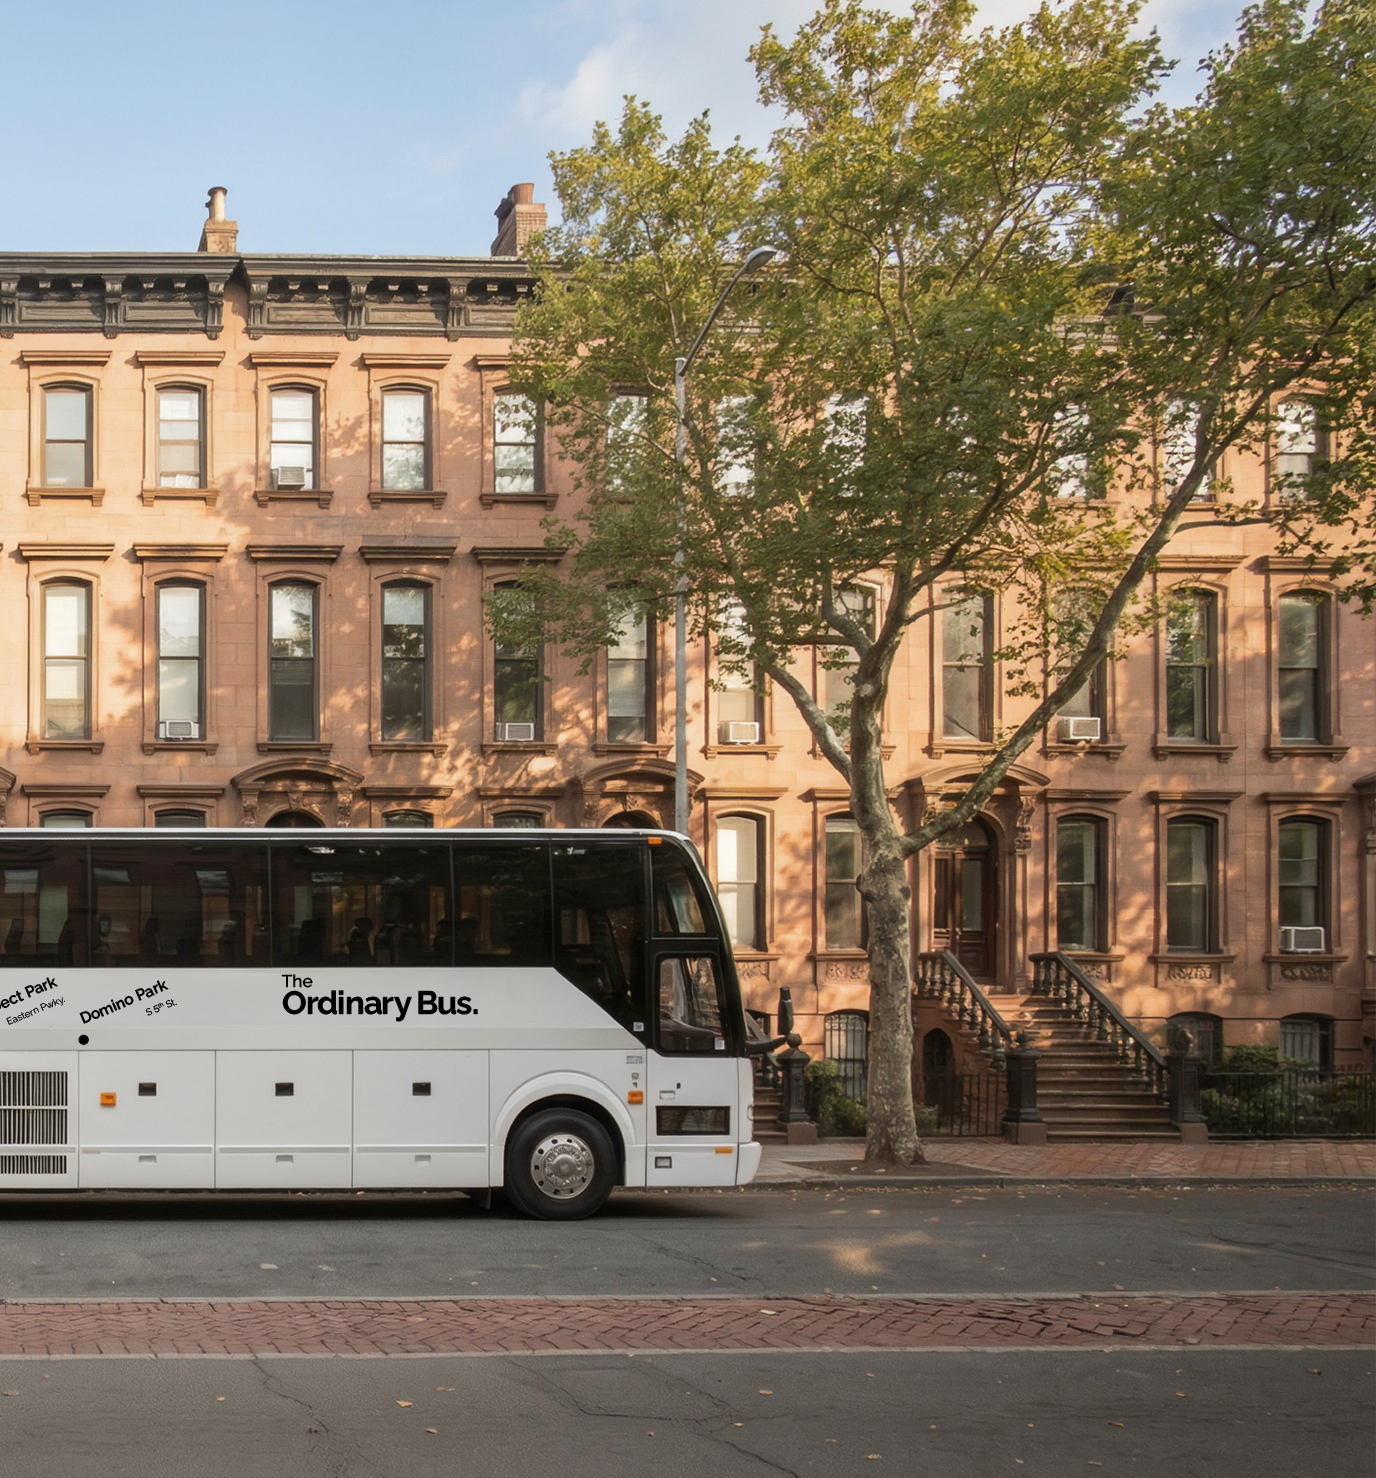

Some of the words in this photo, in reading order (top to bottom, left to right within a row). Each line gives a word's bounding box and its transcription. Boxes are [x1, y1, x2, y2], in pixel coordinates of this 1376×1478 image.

[25, 977, 58, 998] Park
[282, 974, 313, 988] The
[6, 1007, 40, 1025] Eastern
[40, 997, 65, 1011] Pwky.
[79, 995, 135, 1024] Domino
[135, 980, 168, 1001] Park
[145, 1007, 153, 1016] S
[153, 1002, 165, 1014] 5th
[165, 998, 178, 1009] St.
[282, 990, 413, 1022] Ordinary
[417, 990, 479, 1016] Bus.
